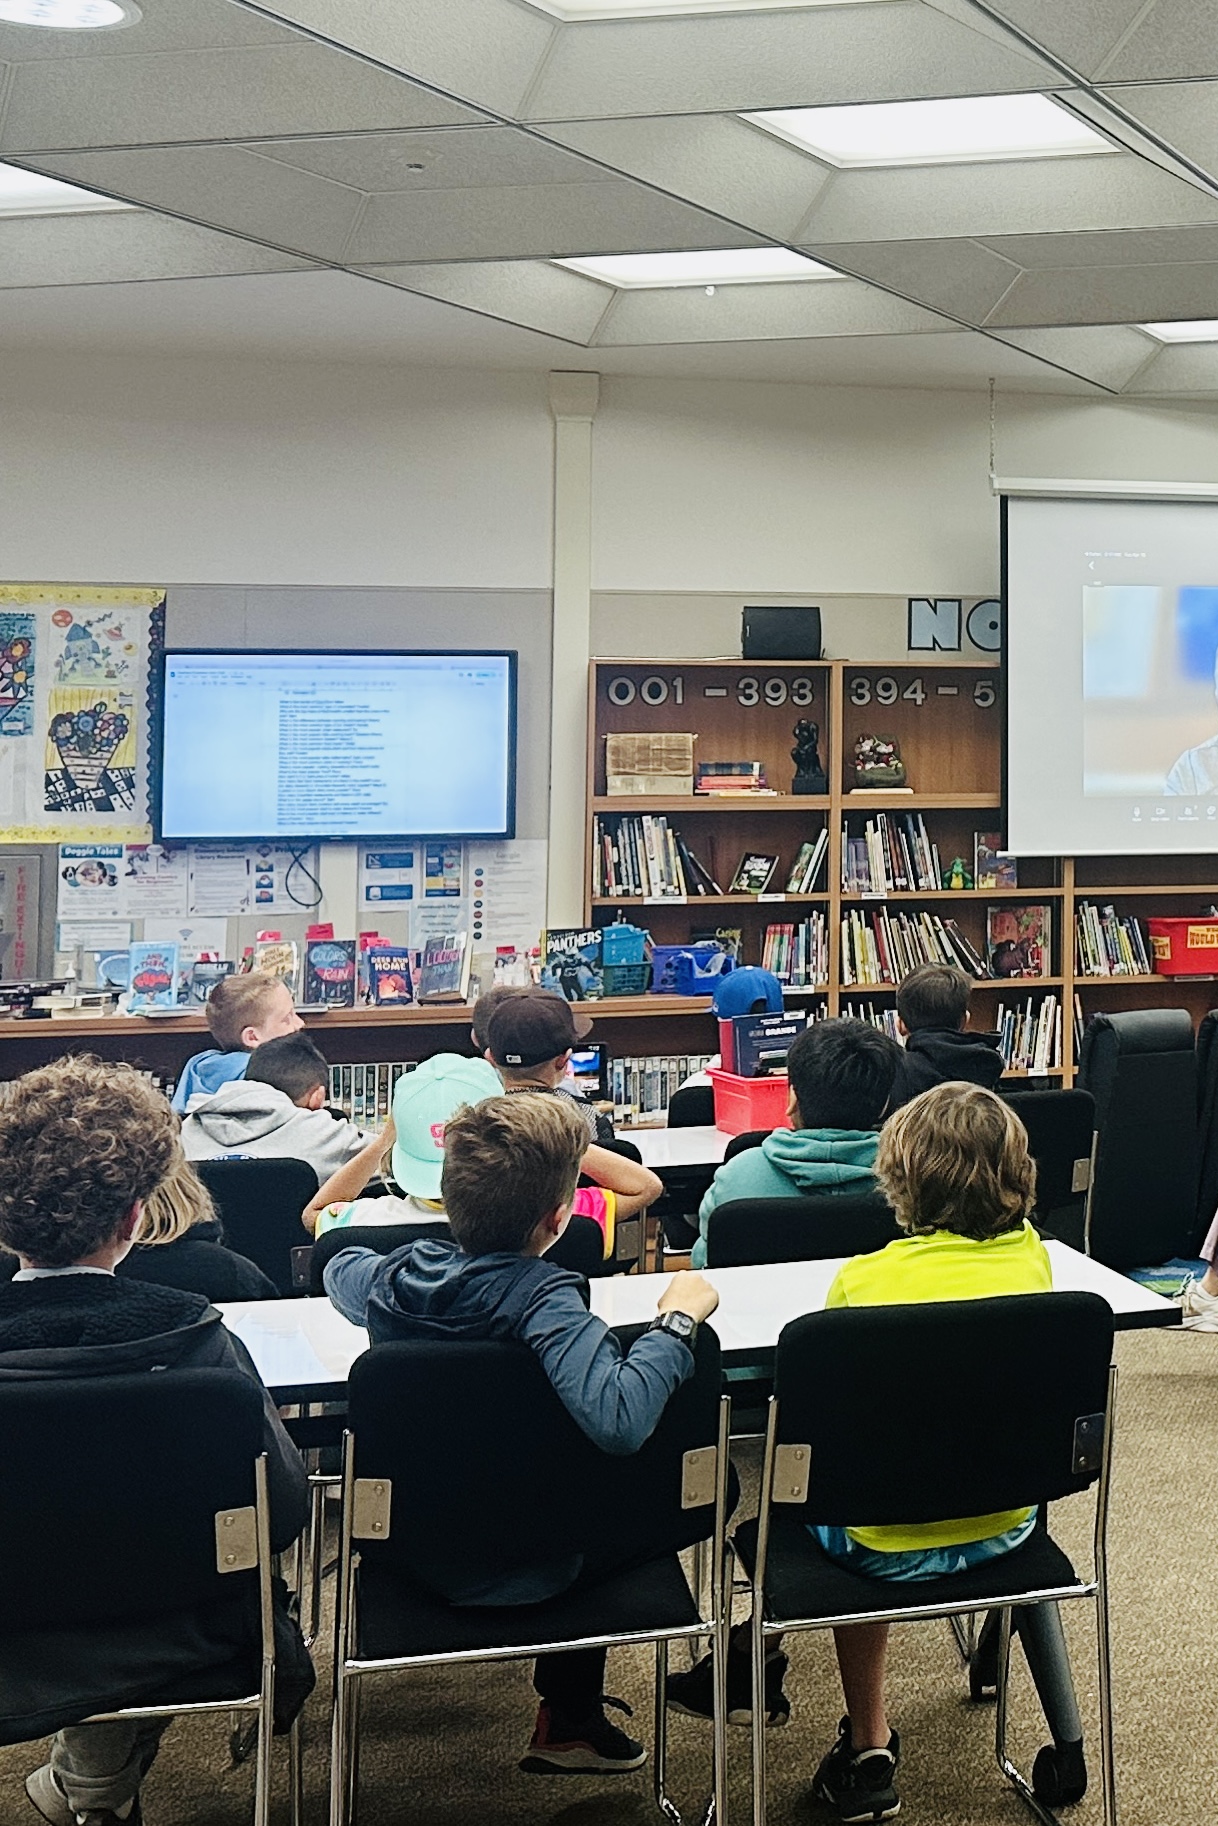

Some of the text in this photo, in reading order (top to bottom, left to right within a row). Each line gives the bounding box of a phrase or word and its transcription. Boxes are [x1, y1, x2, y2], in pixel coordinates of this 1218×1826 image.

[65, 846, 119, 856] Doggie Tales
[14, 905, 25, 979] EXTINGUI
[547, 930, 602, 954] PANTHERS
[1189, 932, 1215, 946] WOULD
[310, 949, 348, 962] COLORS
[375, 963, 406, 971] HOME
[322, 968, 349, 980] RAIN
